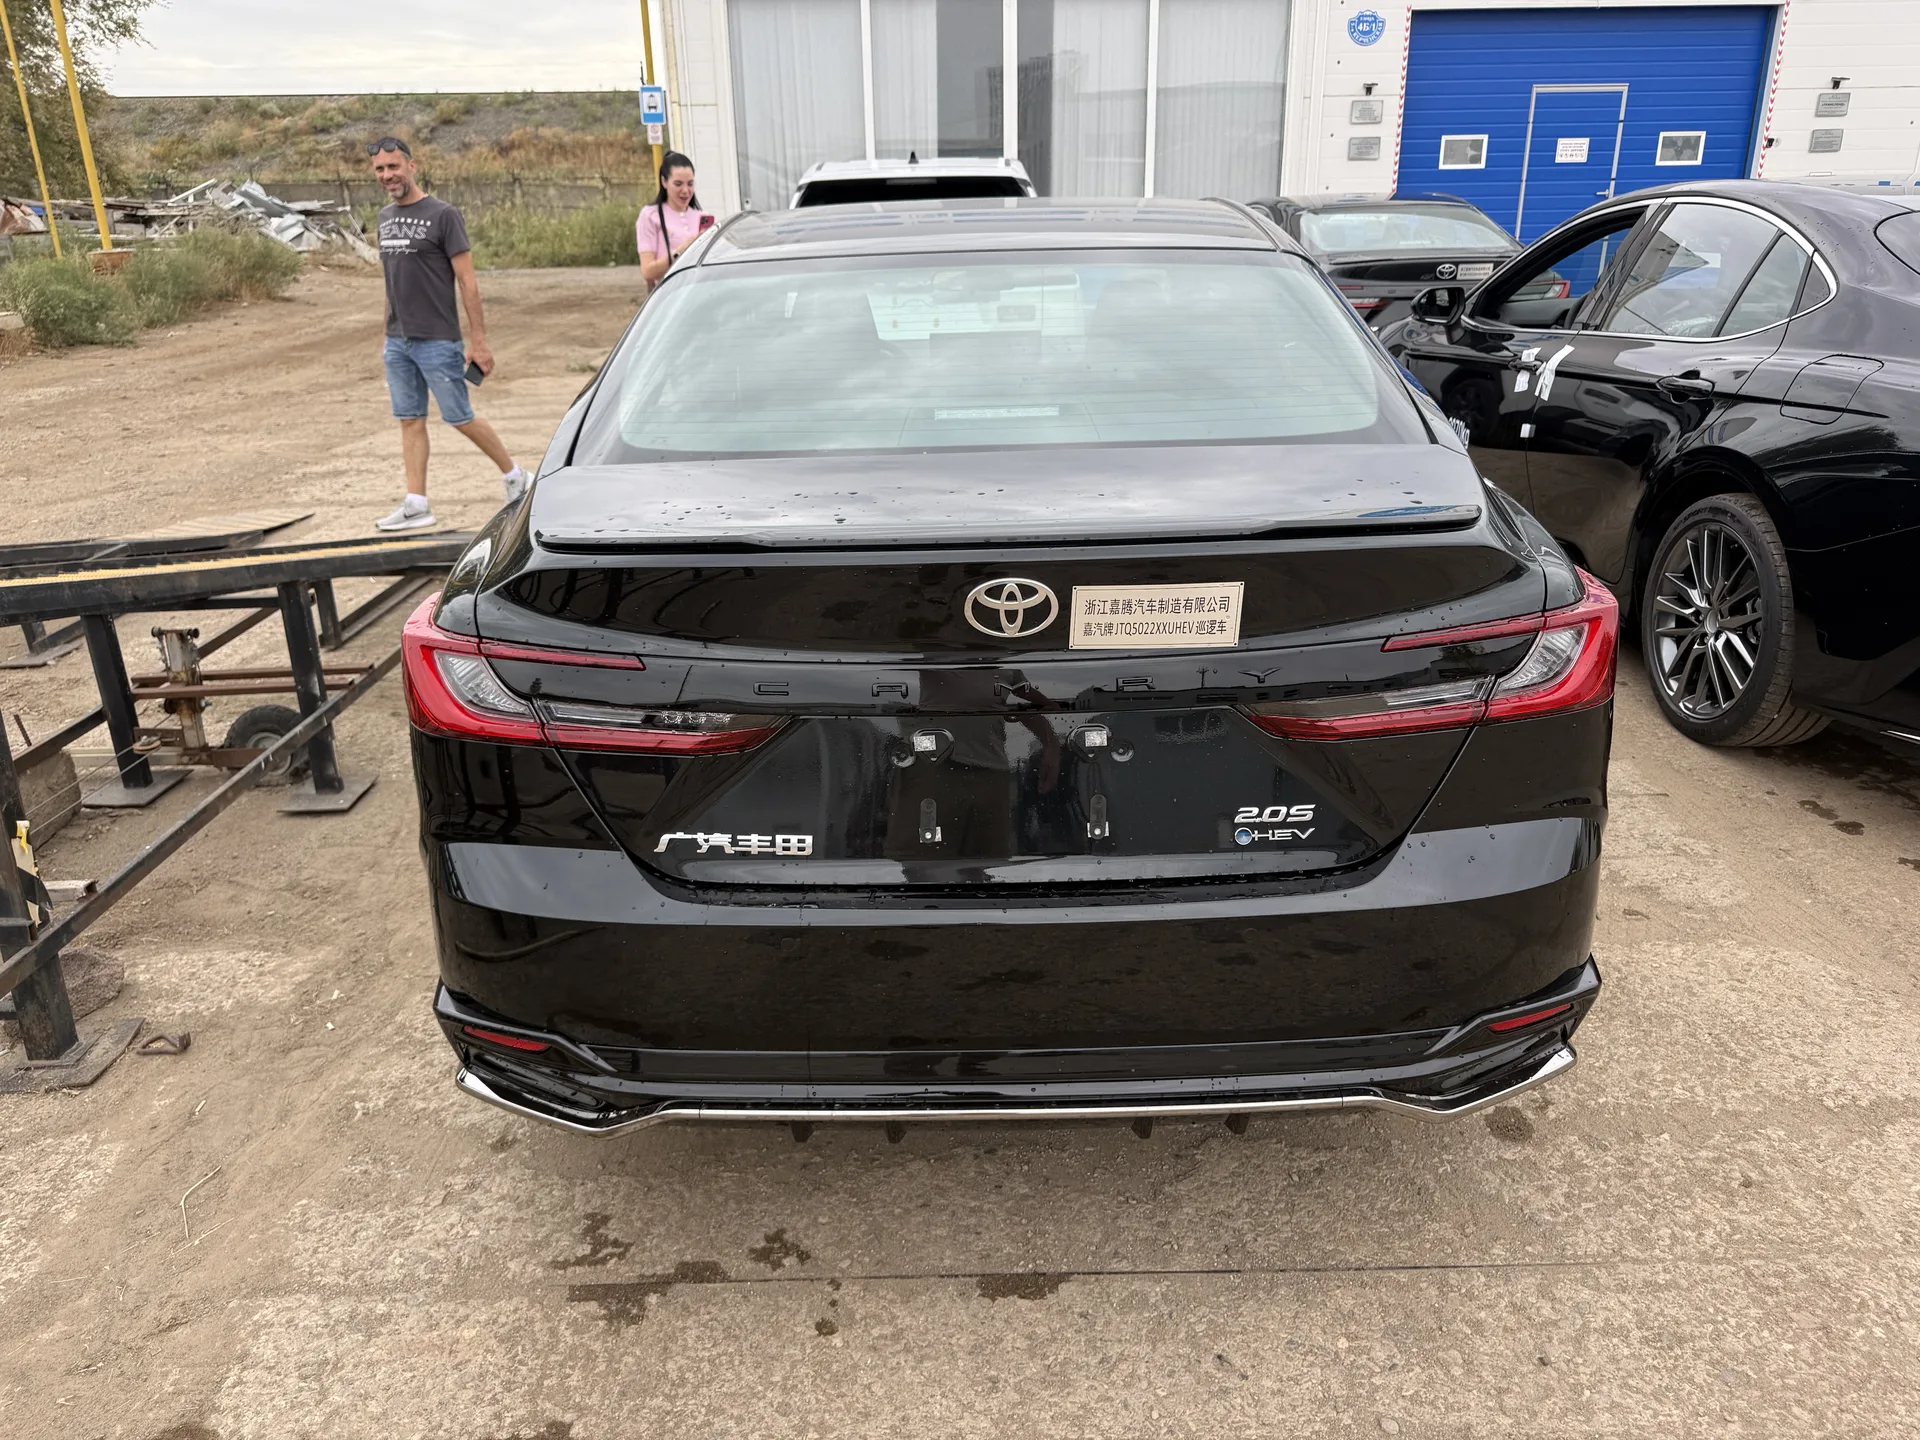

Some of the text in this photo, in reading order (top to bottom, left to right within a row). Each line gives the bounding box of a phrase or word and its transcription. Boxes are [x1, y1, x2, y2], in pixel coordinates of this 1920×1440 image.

[1357, 22, 1376, 32] 4Б/1
[1084, 596, 1230, 616] 浙江嘉腾汽车制造有限公司
[753, 667, 1282, 697] CAMRY
[1234, 804, 1316, 823] 2.0S
[654, 831, 813, 856] 广汽丰田
